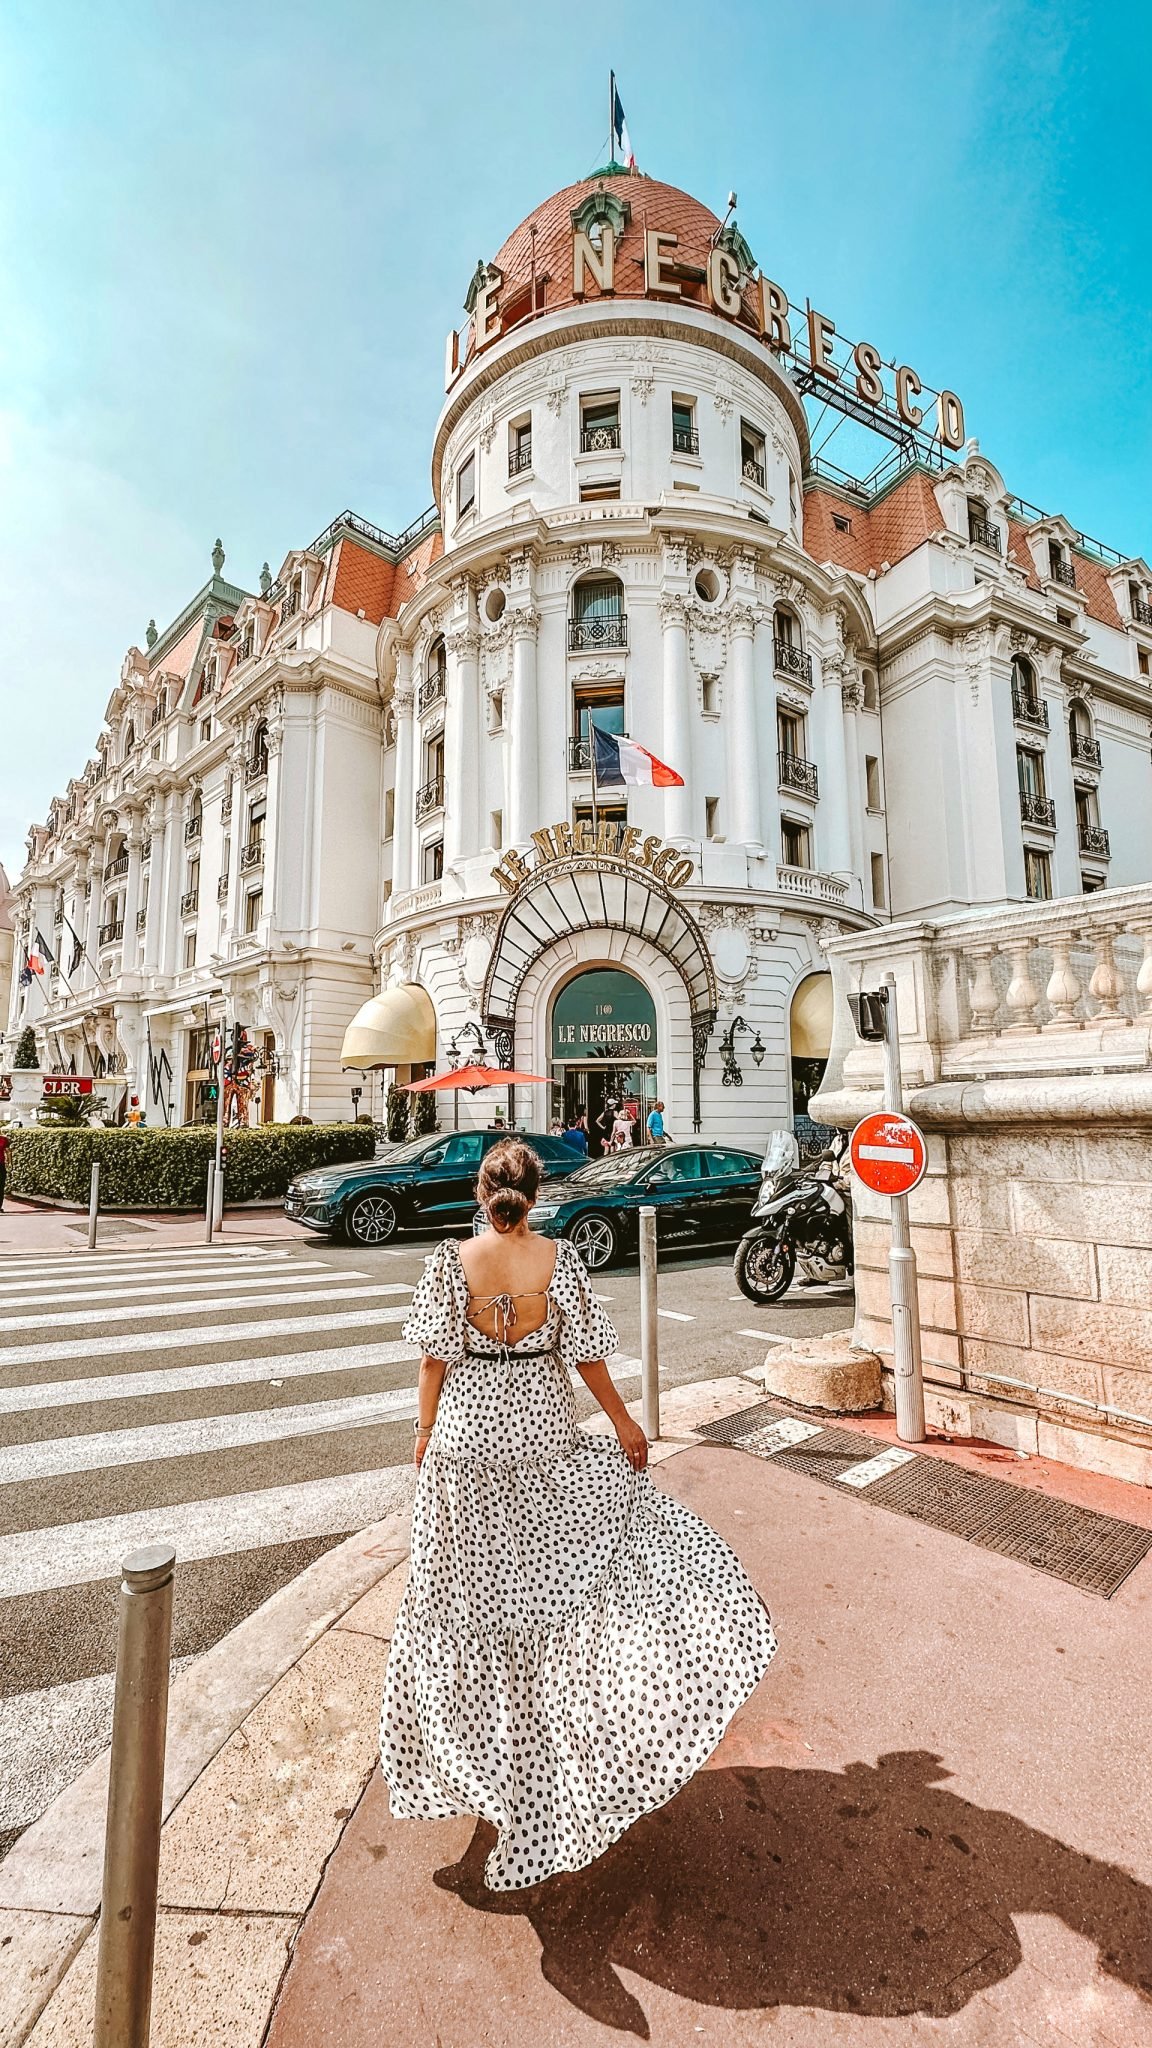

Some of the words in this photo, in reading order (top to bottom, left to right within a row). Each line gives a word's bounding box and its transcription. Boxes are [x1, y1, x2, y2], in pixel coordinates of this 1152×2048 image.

[445, 275, 504, 394] LE
[572, 227, 966, 452] NEGRESCO
[490, 850, 530, 895] LE
[531, 819, 694, 889] NEGRESCO
[558, 1025, 575, 1043] LE
[580, 1023, 651, 1043] NEGRESCO
